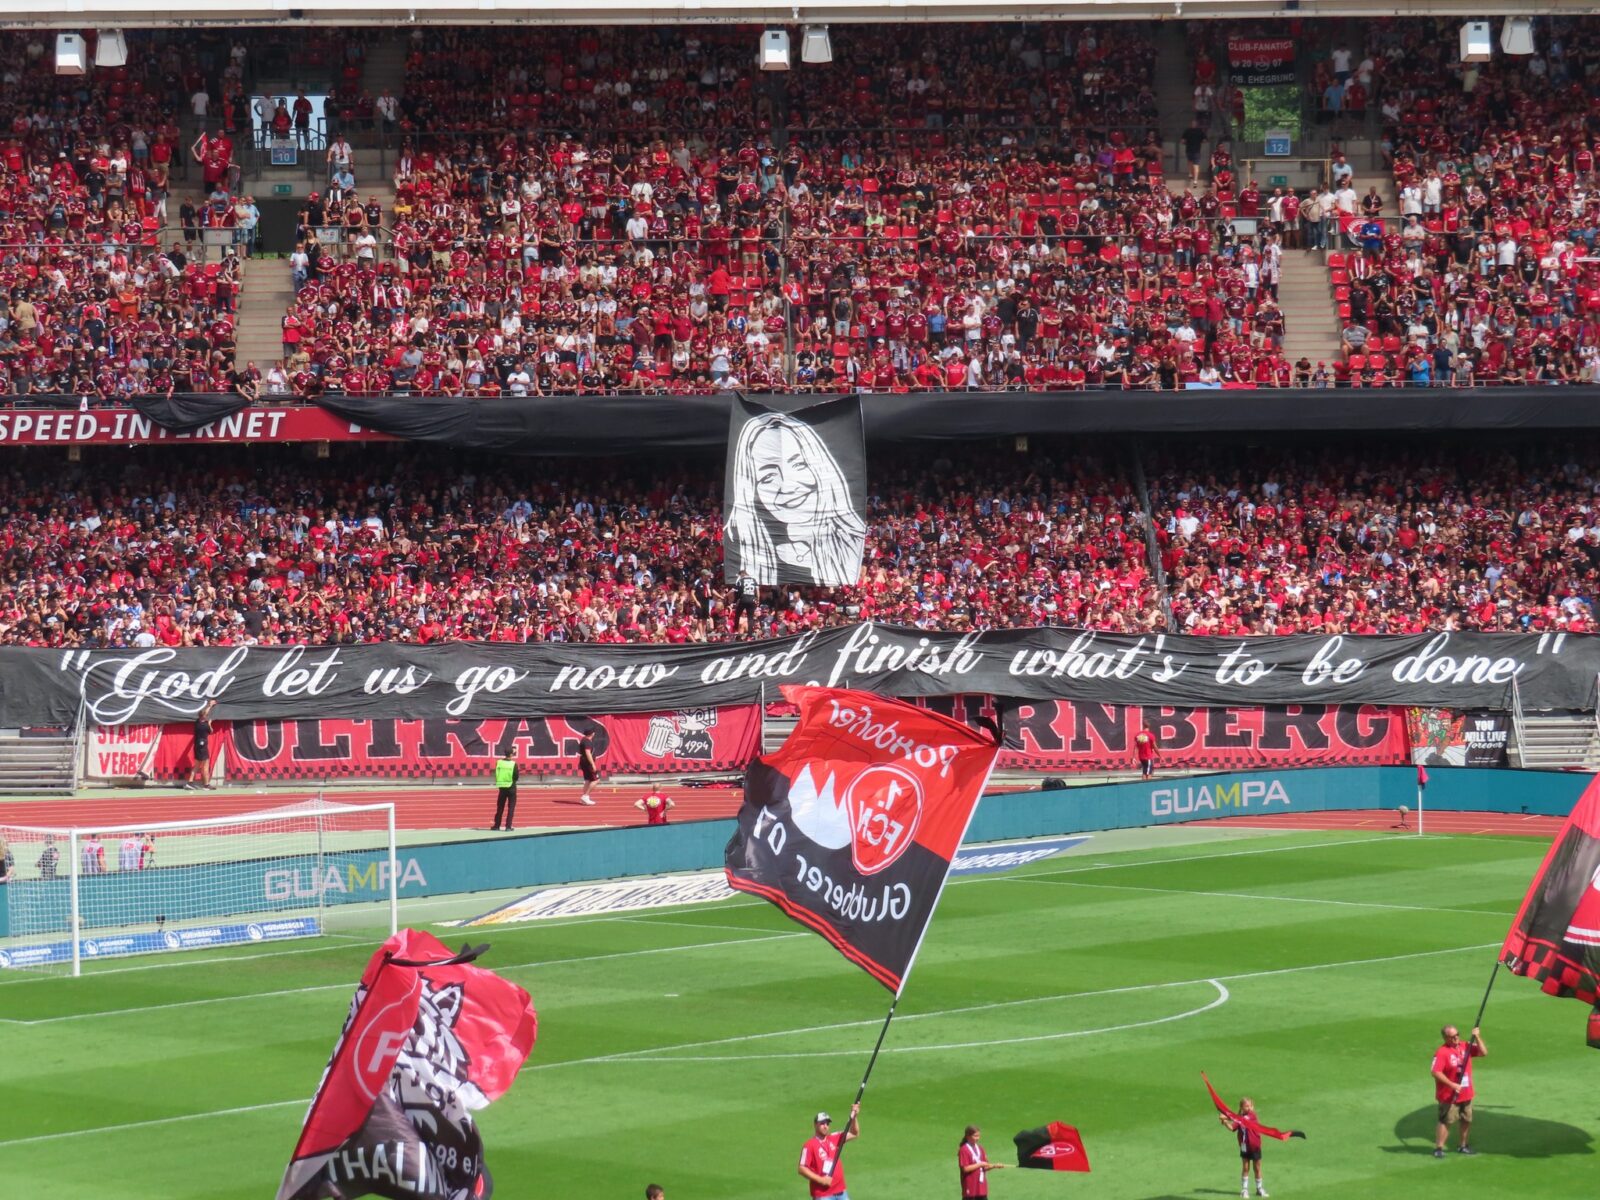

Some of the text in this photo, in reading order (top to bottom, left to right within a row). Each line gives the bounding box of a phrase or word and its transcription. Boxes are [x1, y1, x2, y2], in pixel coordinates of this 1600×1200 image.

[1228, 40, 1293, 51] CLUB-FANATICS
[1272, 143, 1283, 153] 12
[280, 152, 290, 162] 10
[0, 411, 286, 439] SPEED-INRNET
[261, 645, 343, 697] let
[364, 664, 432, 694] us
[446, 664, 529, 716] go
[550, 662, 679, 693] now
[701, 629, 819, 685] and
[806, 621, 984, 687] finish
[1008, 631, 1190, 682] what's
[1214, 641, 1278, 686] to
[1301, 635, 1371, 686] be
[1474, 720, 1494, 731] YOU
[1487, 731, 1507, 741] LIVE
[685, 741, 709, 753] 1994
[1151, 780, 1291, 816] GUAMPA
[264, 858, 427, 901] GUAMPA
